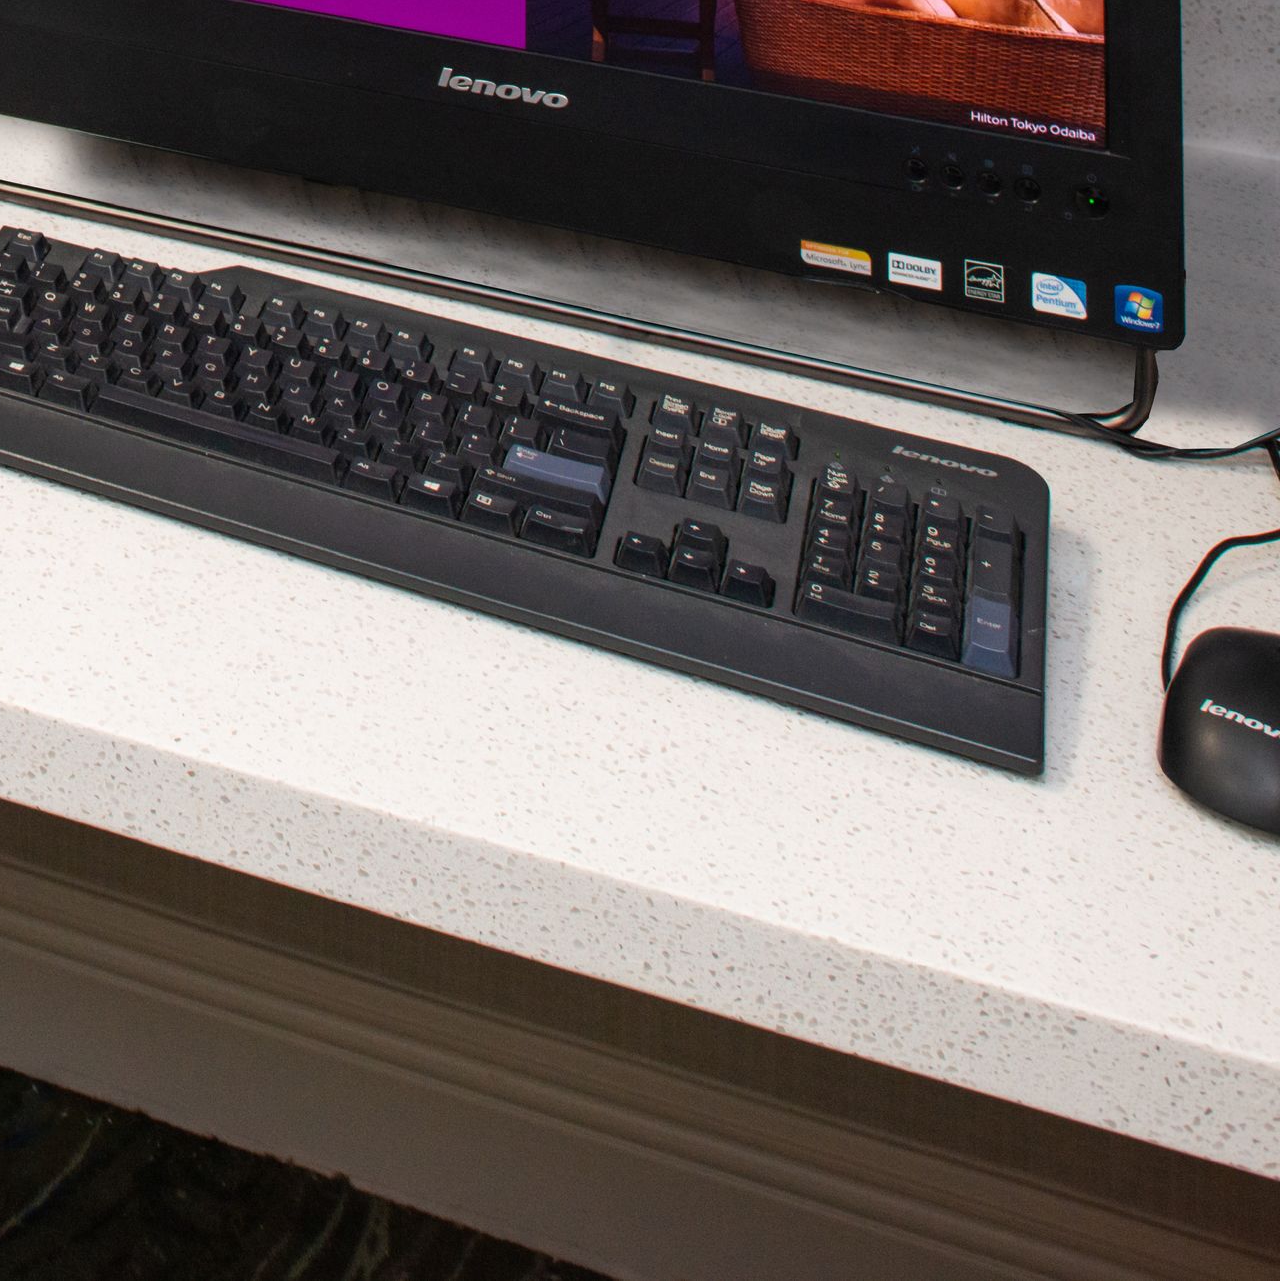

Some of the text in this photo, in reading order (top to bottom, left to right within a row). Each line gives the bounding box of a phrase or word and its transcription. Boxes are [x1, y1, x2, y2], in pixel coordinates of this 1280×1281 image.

[438, 66, 569, 108] lenovo
[970, 110, 1096, 141] Hilton Tokyo Odaiba
[905, 262, 937, 275] DOLBY
[1040, 281, 1060, 292] intel
[44, 292, 56, 301] Q
[1036, 294, 1078, 309] Pentium
[84, 303, 96, 312] W
[41, 318, 51, 326] A
[124, 313, 134, 323] E
[82, 328, 92, 336] S
[164, 324, 175, 334] R
[122, 339, 133, 347] D
[207, 335, 216, 345] T
[46, 343, 59, 352] Z
[248, 347, 258, 357] Y
[88, 354, 99, 363] X
[290, 358, 301, 368] U
[130, 367, 141, 375] C
[205, 362, 216, 371] G
[173, 378, 183, 387] V
[246, 374, 259, 383] H
[214, 390, 225, 399] B
[290, 386, 300, 394] J
[420, 392, 432, 401] P
[258, 402, 270, 411] N
[334, 397, 345, 407] K
[378, 409, 387, 418] L
[559, 404, 605, 421] Backspace
[301, 414, 315, 424] M
[655, 429, 678, 440] Insert
[704, 442, 729, 454] Home
[892, 445, 998, 478] lenovo
[699, 471, 716, 481] End
[750, 481, 773, 492] Page
[749, 487, 775, 498] Down
[823, 498, 834, 509] 7
[874, 513, 885, 523] 8
[818, 528, 830, 537] 4
[927, 526, 938, 536] 9
[871, 541, 882, 551] 5
[925, 556, 936, 566] 6
[868, 570, 879, 578] 2
[922, 585, 934, 594] 3
[919, 621, 937, 631] Del
[1199, 698, 1280, 739] lenov
